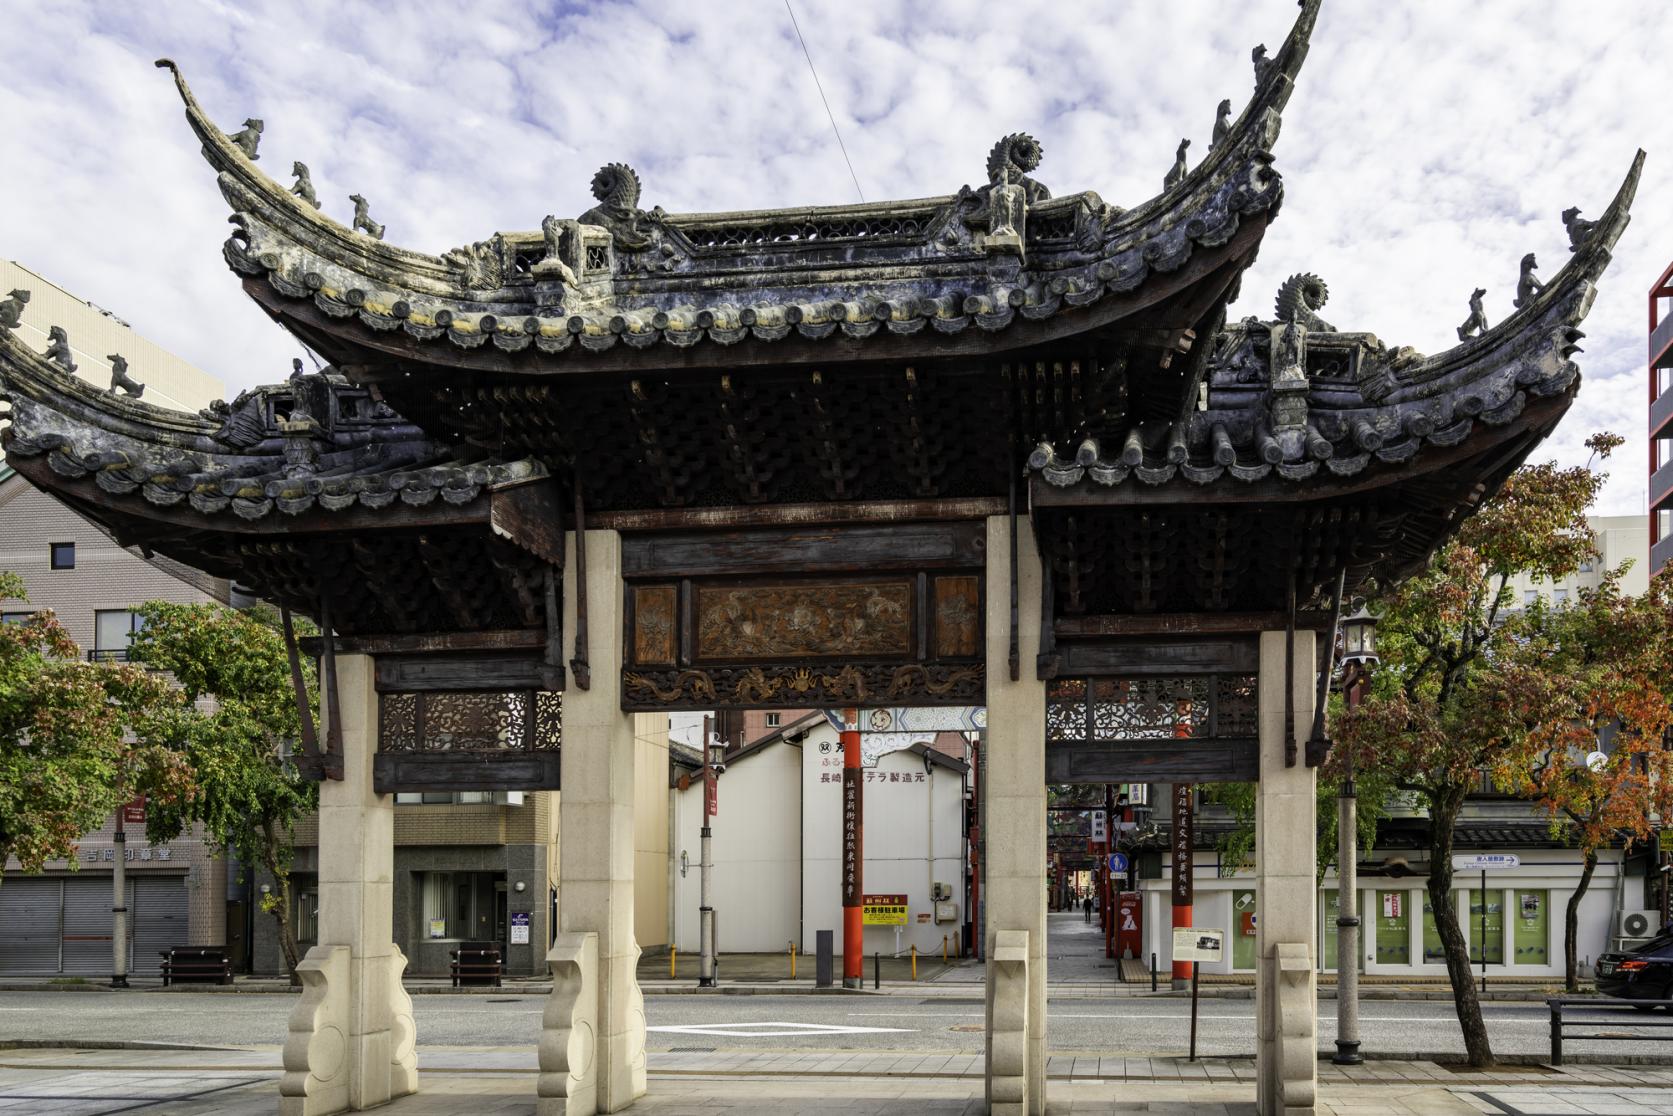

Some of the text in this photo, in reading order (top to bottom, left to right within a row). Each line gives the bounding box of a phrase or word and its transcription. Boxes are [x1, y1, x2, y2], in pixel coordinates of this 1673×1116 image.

[822, 757, 844, 766] ふる
[820, 772, 925, 783] 長崎テラ製造元
